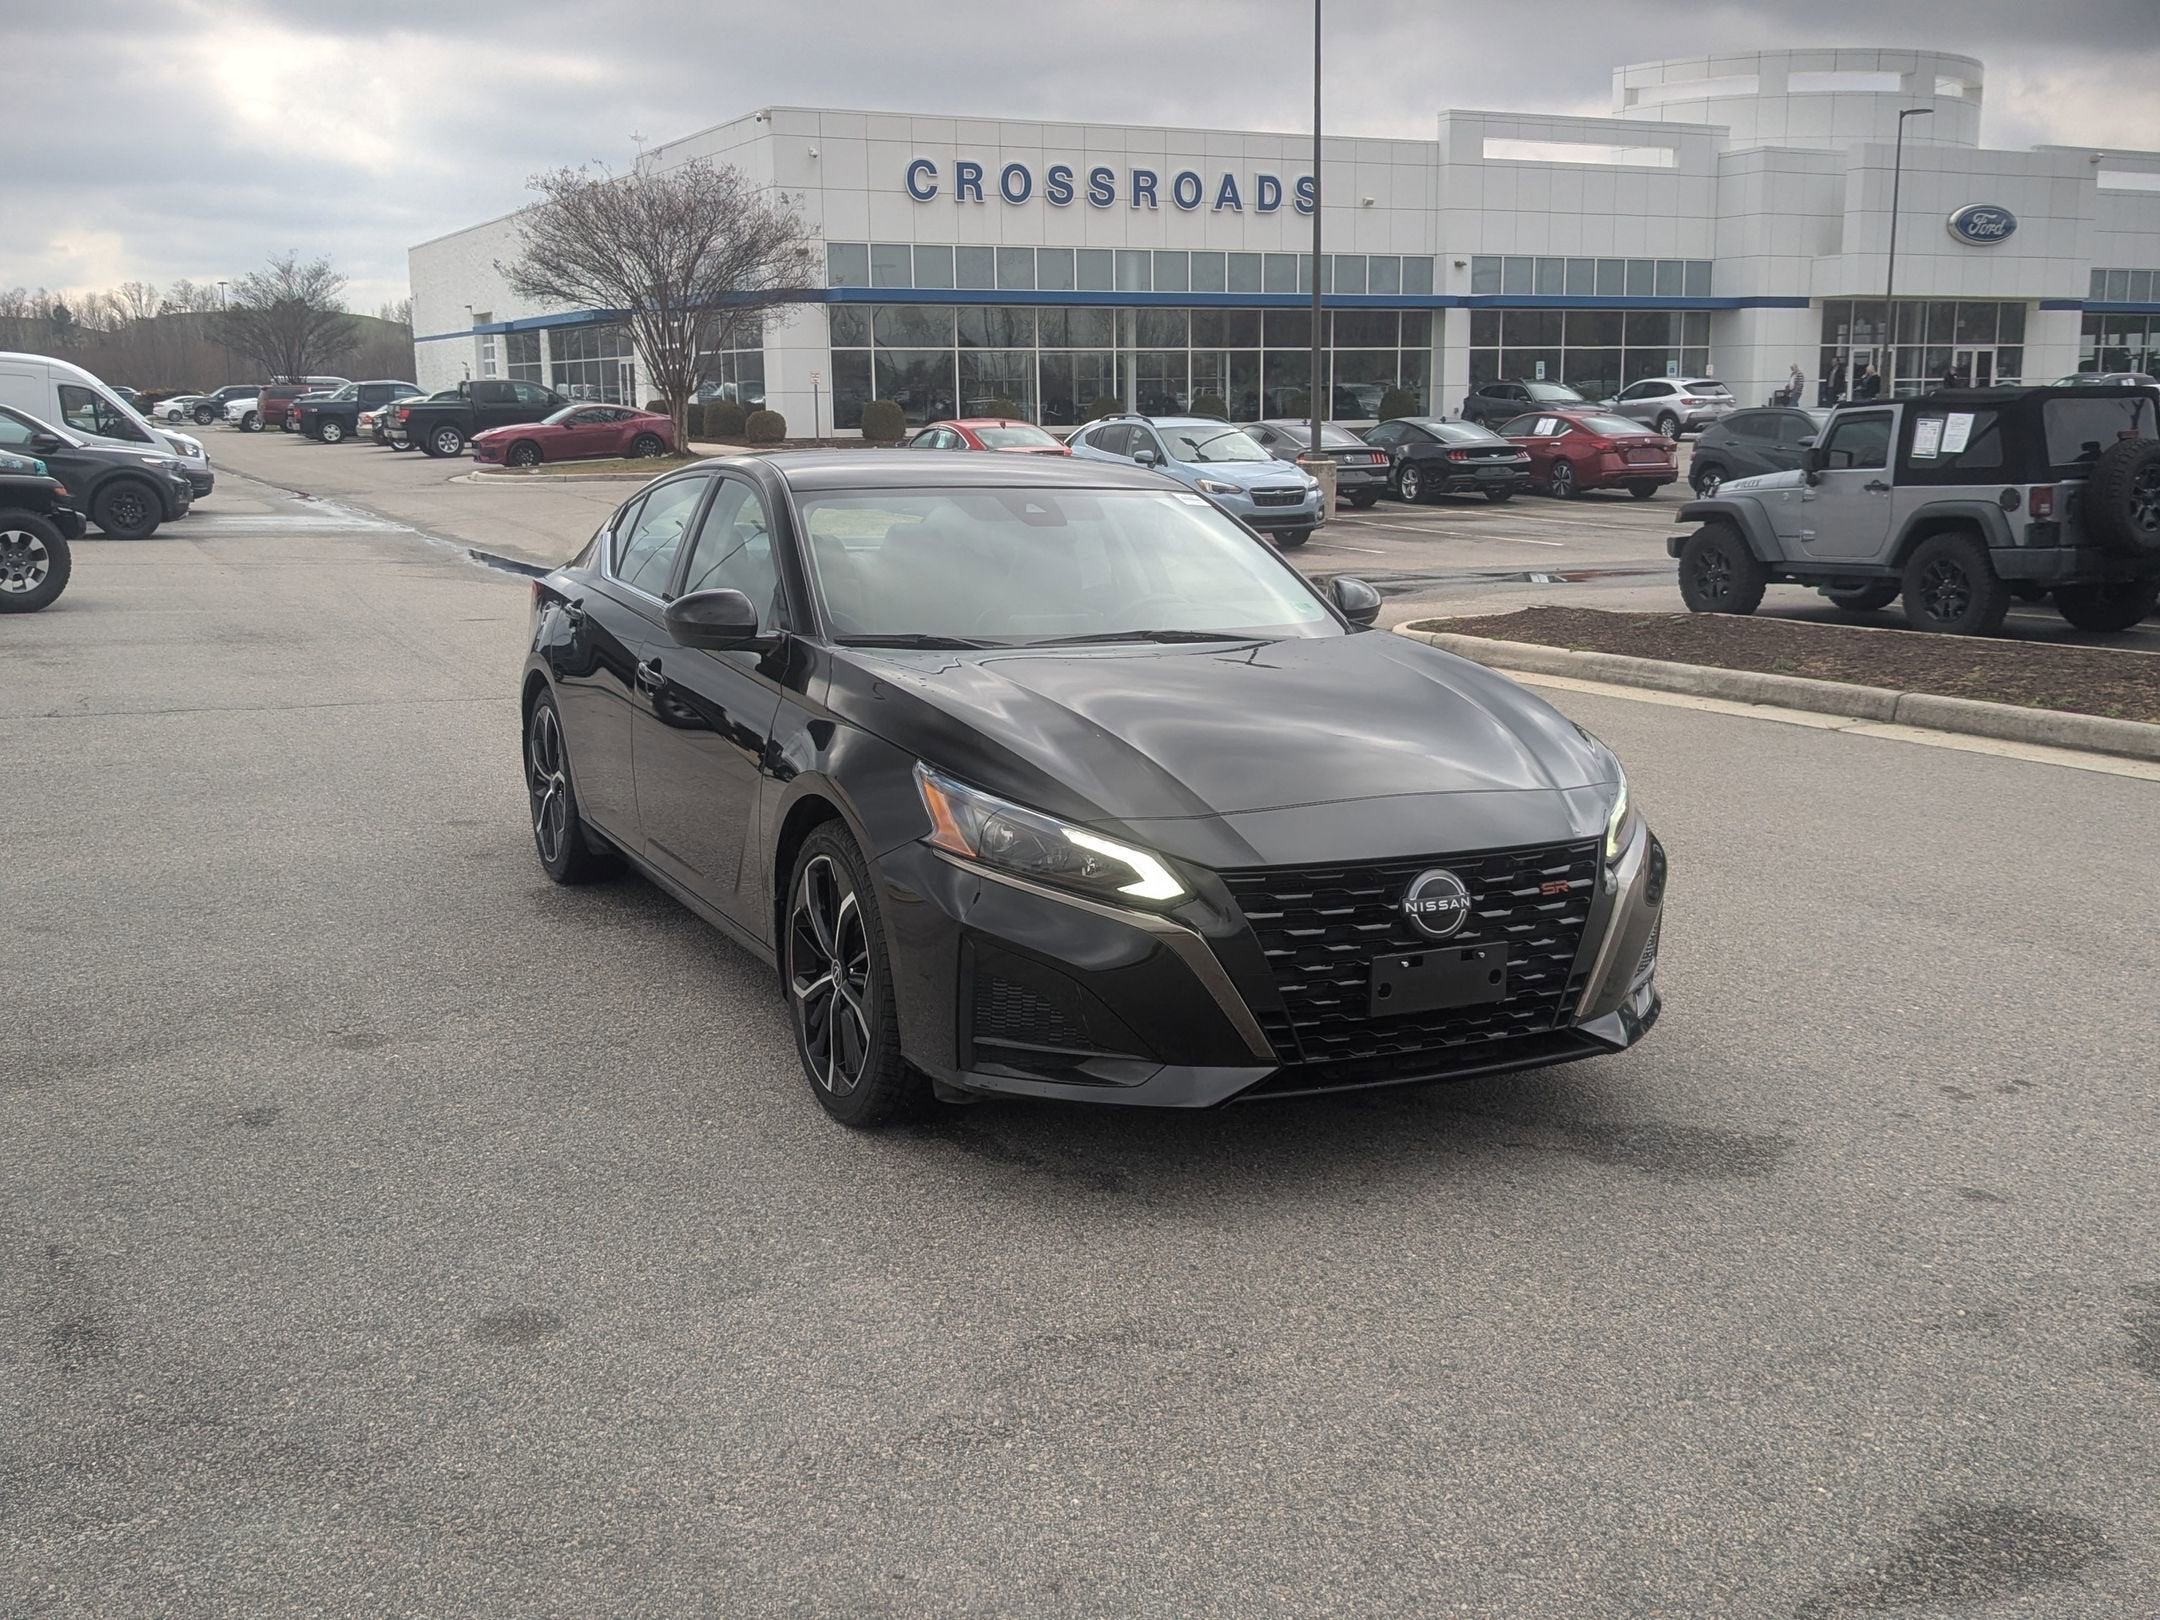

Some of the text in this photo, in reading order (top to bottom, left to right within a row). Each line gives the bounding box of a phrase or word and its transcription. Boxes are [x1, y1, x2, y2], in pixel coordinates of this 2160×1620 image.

[905, 158, 1314, 215] CROSSROADS
[1967, 212, 2007, 235] Ford
[1541, 879, 1569, 896] SR
[1404, 896, 1470, 913] NISSAN
